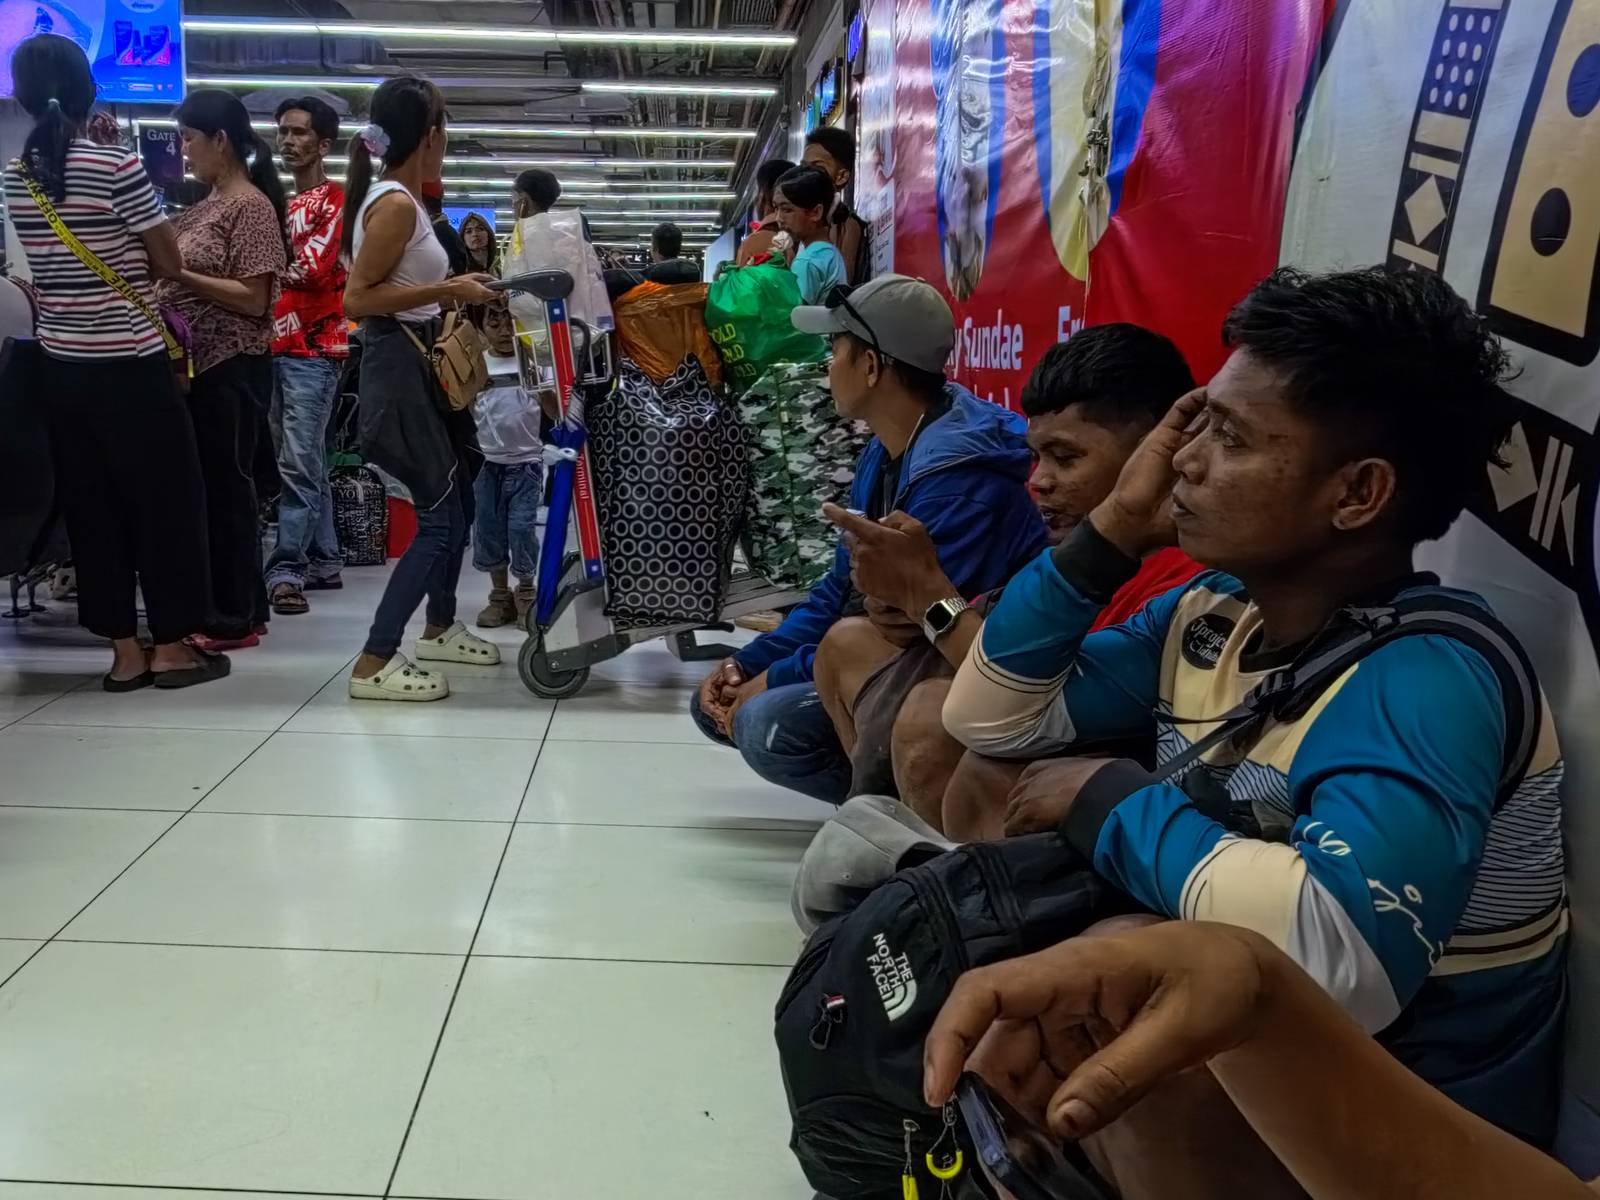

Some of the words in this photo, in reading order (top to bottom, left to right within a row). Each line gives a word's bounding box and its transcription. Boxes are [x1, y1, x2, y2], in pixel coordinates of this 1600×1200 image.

[166, 141, 176, 155] 4
[708, 323, 737, 344] OLD
[963, 308, 1024, 370] Sundae
[576, 452, 590, 500] Terminal
[866, 953, 891, 996] FACE
[873, 932, 902, 989] NORTH
[894, 951, 914, 983] THE
